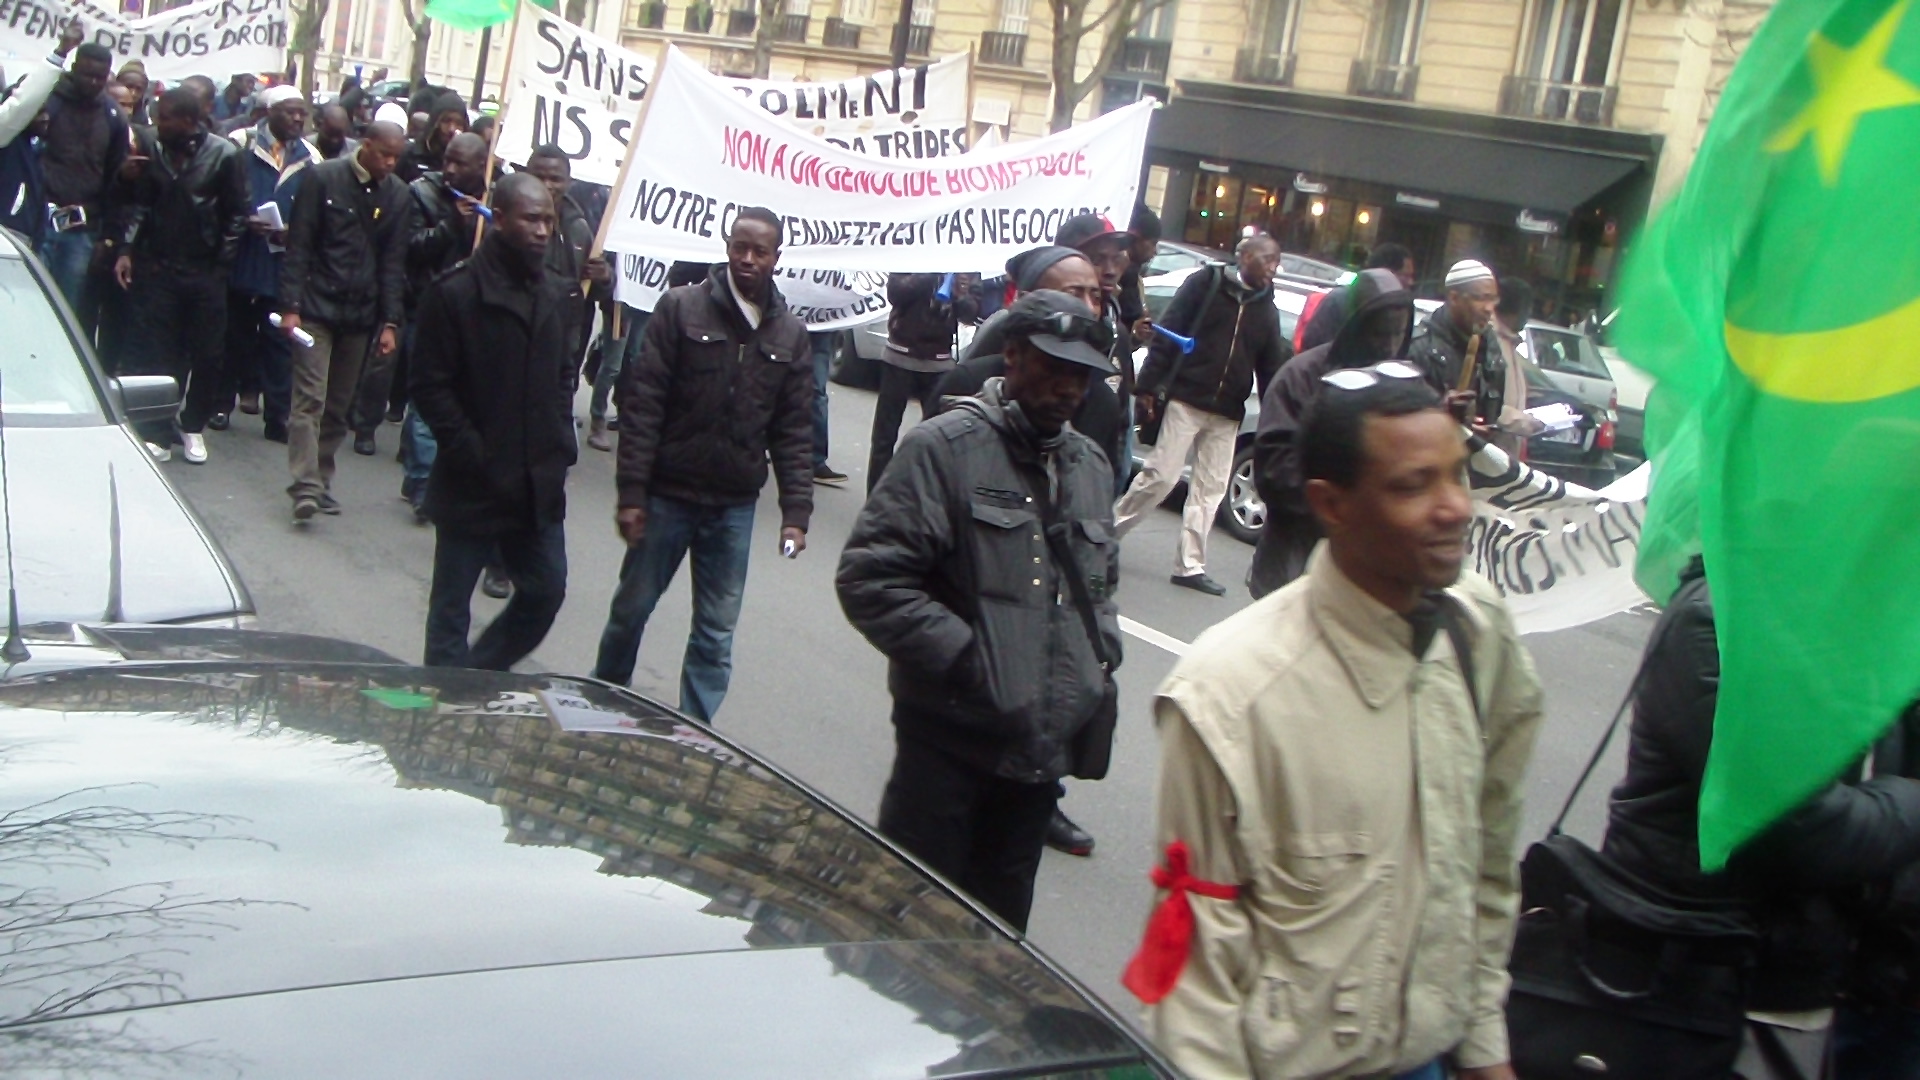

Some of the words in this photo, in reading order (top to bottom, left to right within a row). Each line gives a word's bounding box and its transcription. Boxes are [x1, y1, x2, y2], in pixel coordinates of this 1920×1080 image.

[95, 29, 134, 55] DE
[537, 19, 648, 101] SANS
[721, 125, 771, 176] NON
[771, 143, 789, 180] A
[790, 150, 830, 187] UN
[630, 179, 717, 238] NOTRE
[936, 207, 976, 245] PAS
